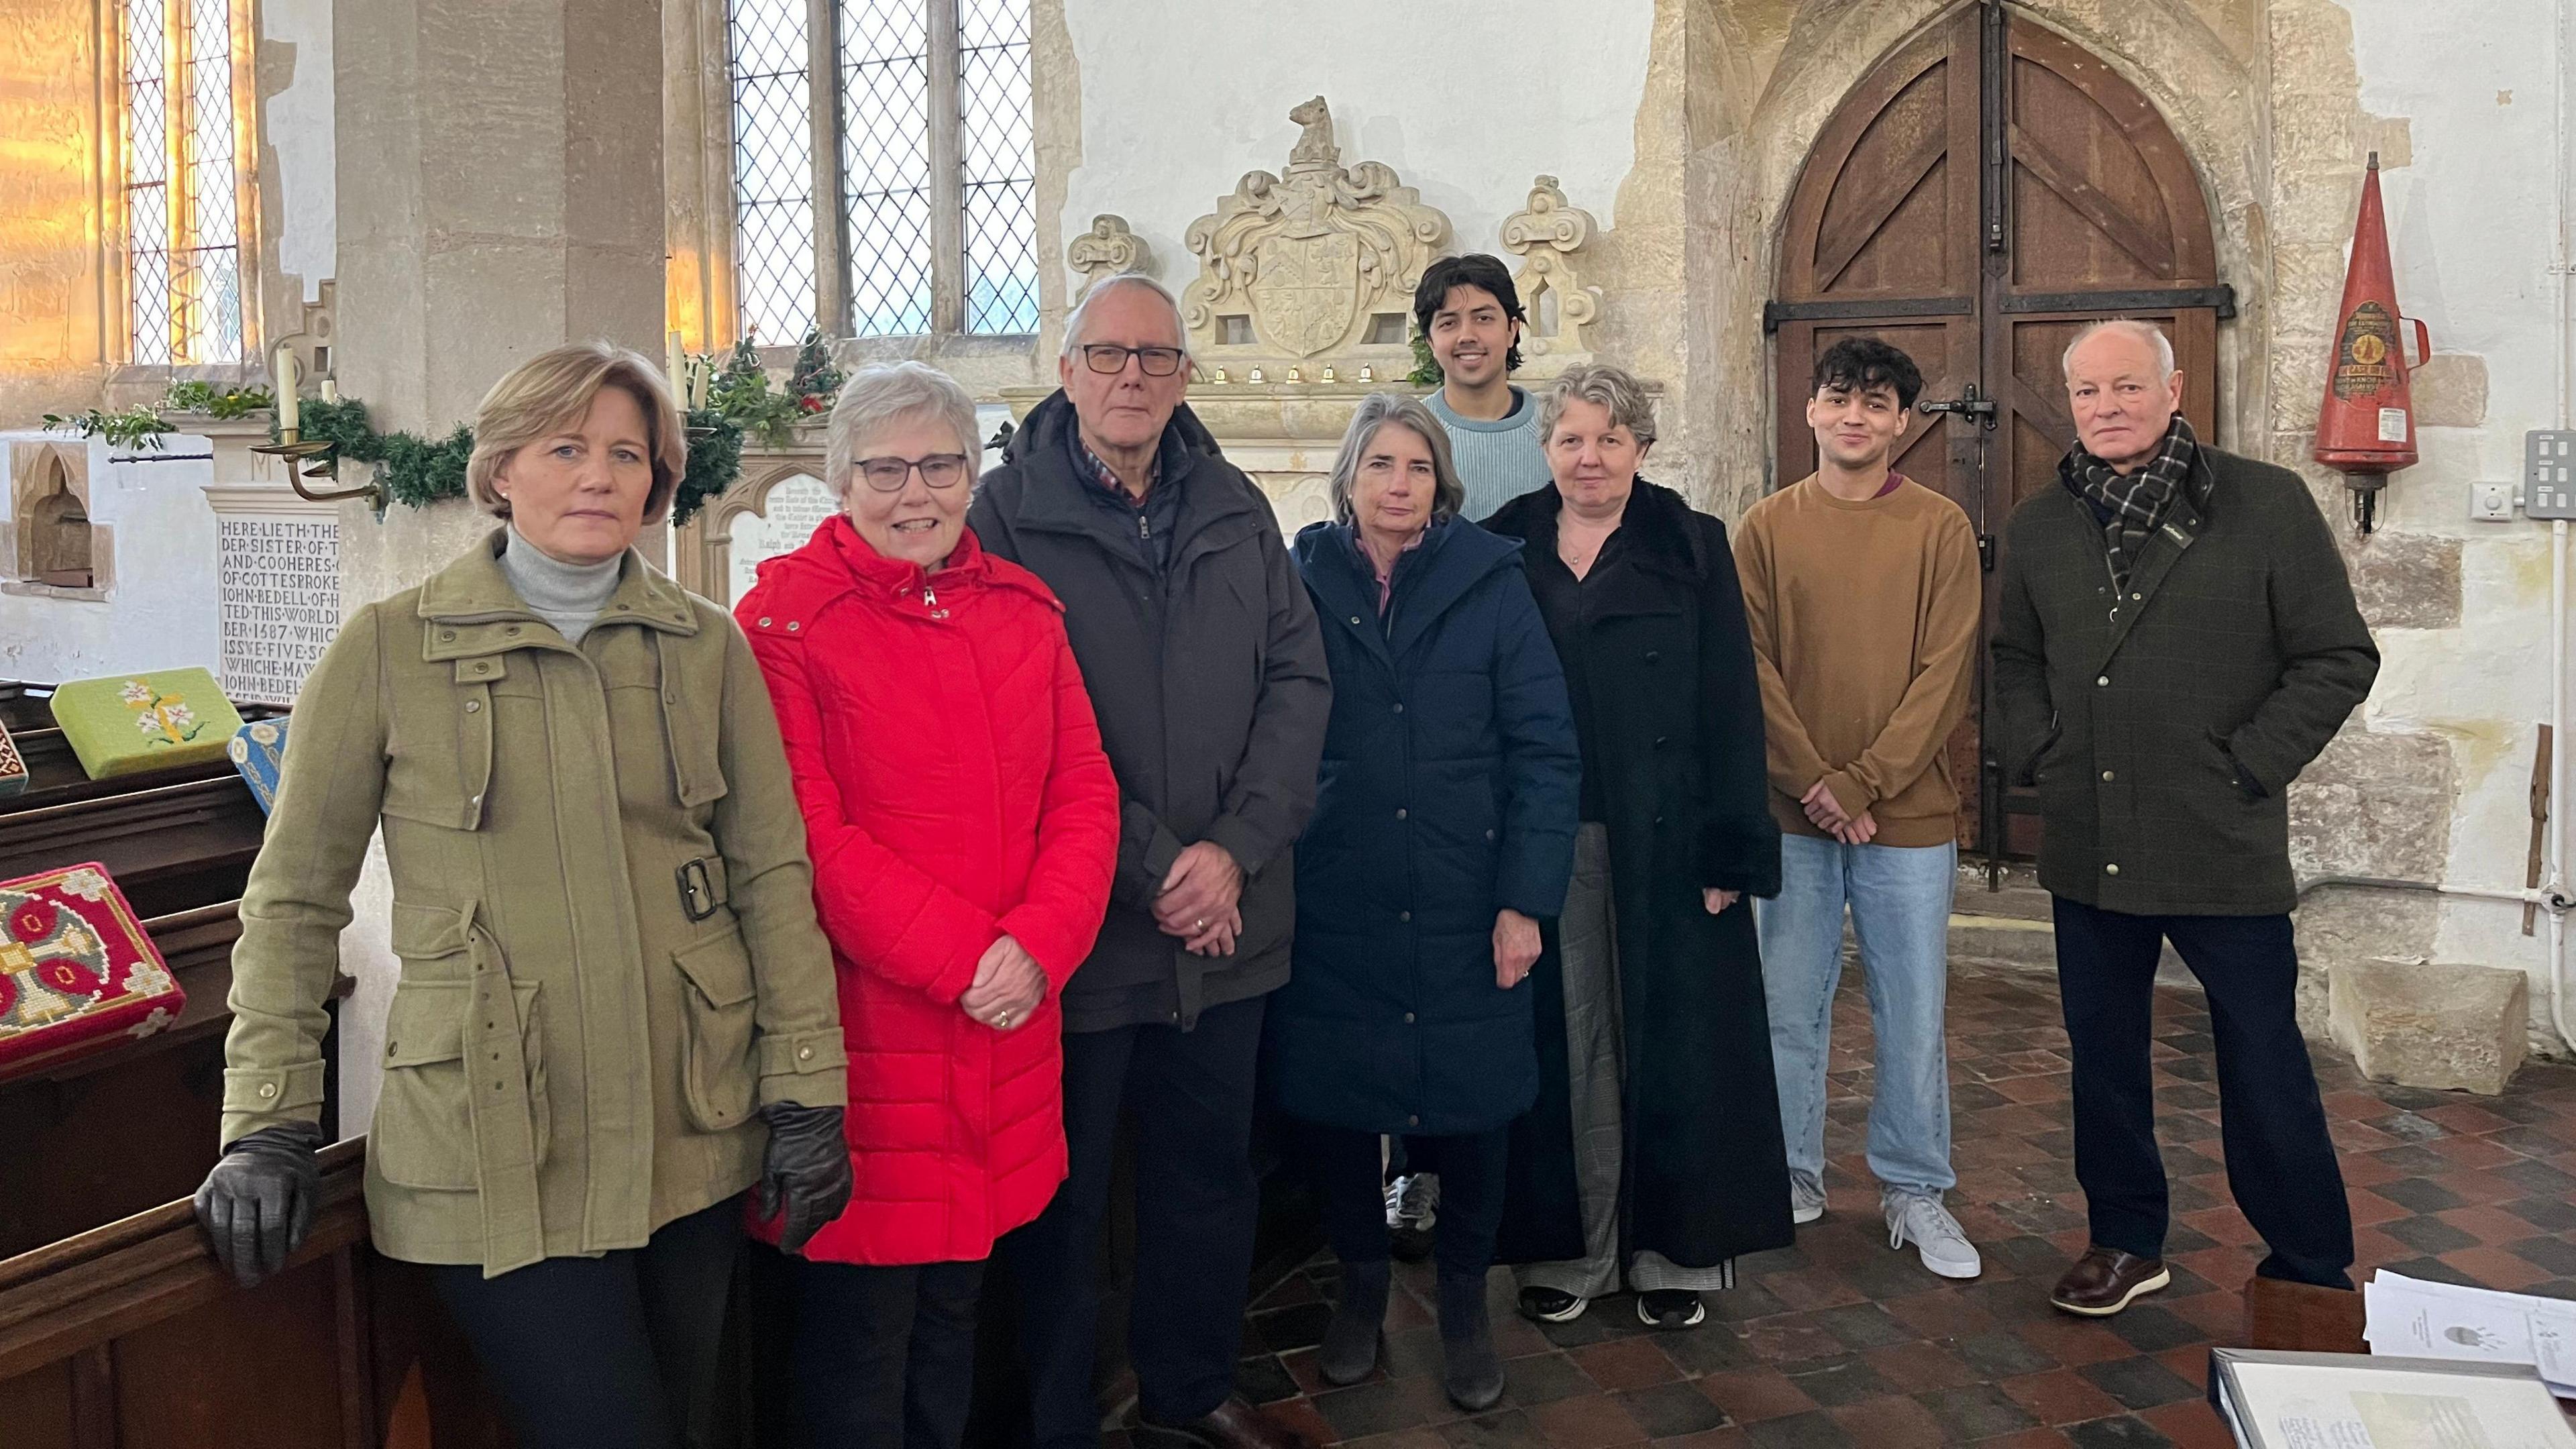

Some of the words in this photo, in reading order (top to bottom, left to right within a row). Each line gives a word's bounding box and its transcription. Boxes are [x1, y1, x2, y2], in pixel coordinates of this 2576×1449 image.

[222, 522, 258, 536] HERE
[262, 523, 306, 537] LIETH
[311, 524, 339, 539] THE
[222, 538, 246, 552] DER
[251, 539, 303, 554] SISTER
[308, 541, 324, 555] OF
[223, 555, 253, 569] AND
[258, 555, 331, 572] COOHERES
[223, 571, 240, 585] OF
[223, 588, 254, 603] IOHN
[258, 589, 308, 605] BEDELL
[311, 592, 327, 606] OF
[224, 604, 250, 619] TED
[252, 606, 281, 621] THIS
[224, 622, 248, 637] BER
[294, 626, 339, 643] WHIC
[268, 642, 304, 659] FIVE
[225, 657, 280, 676] WHICHE
